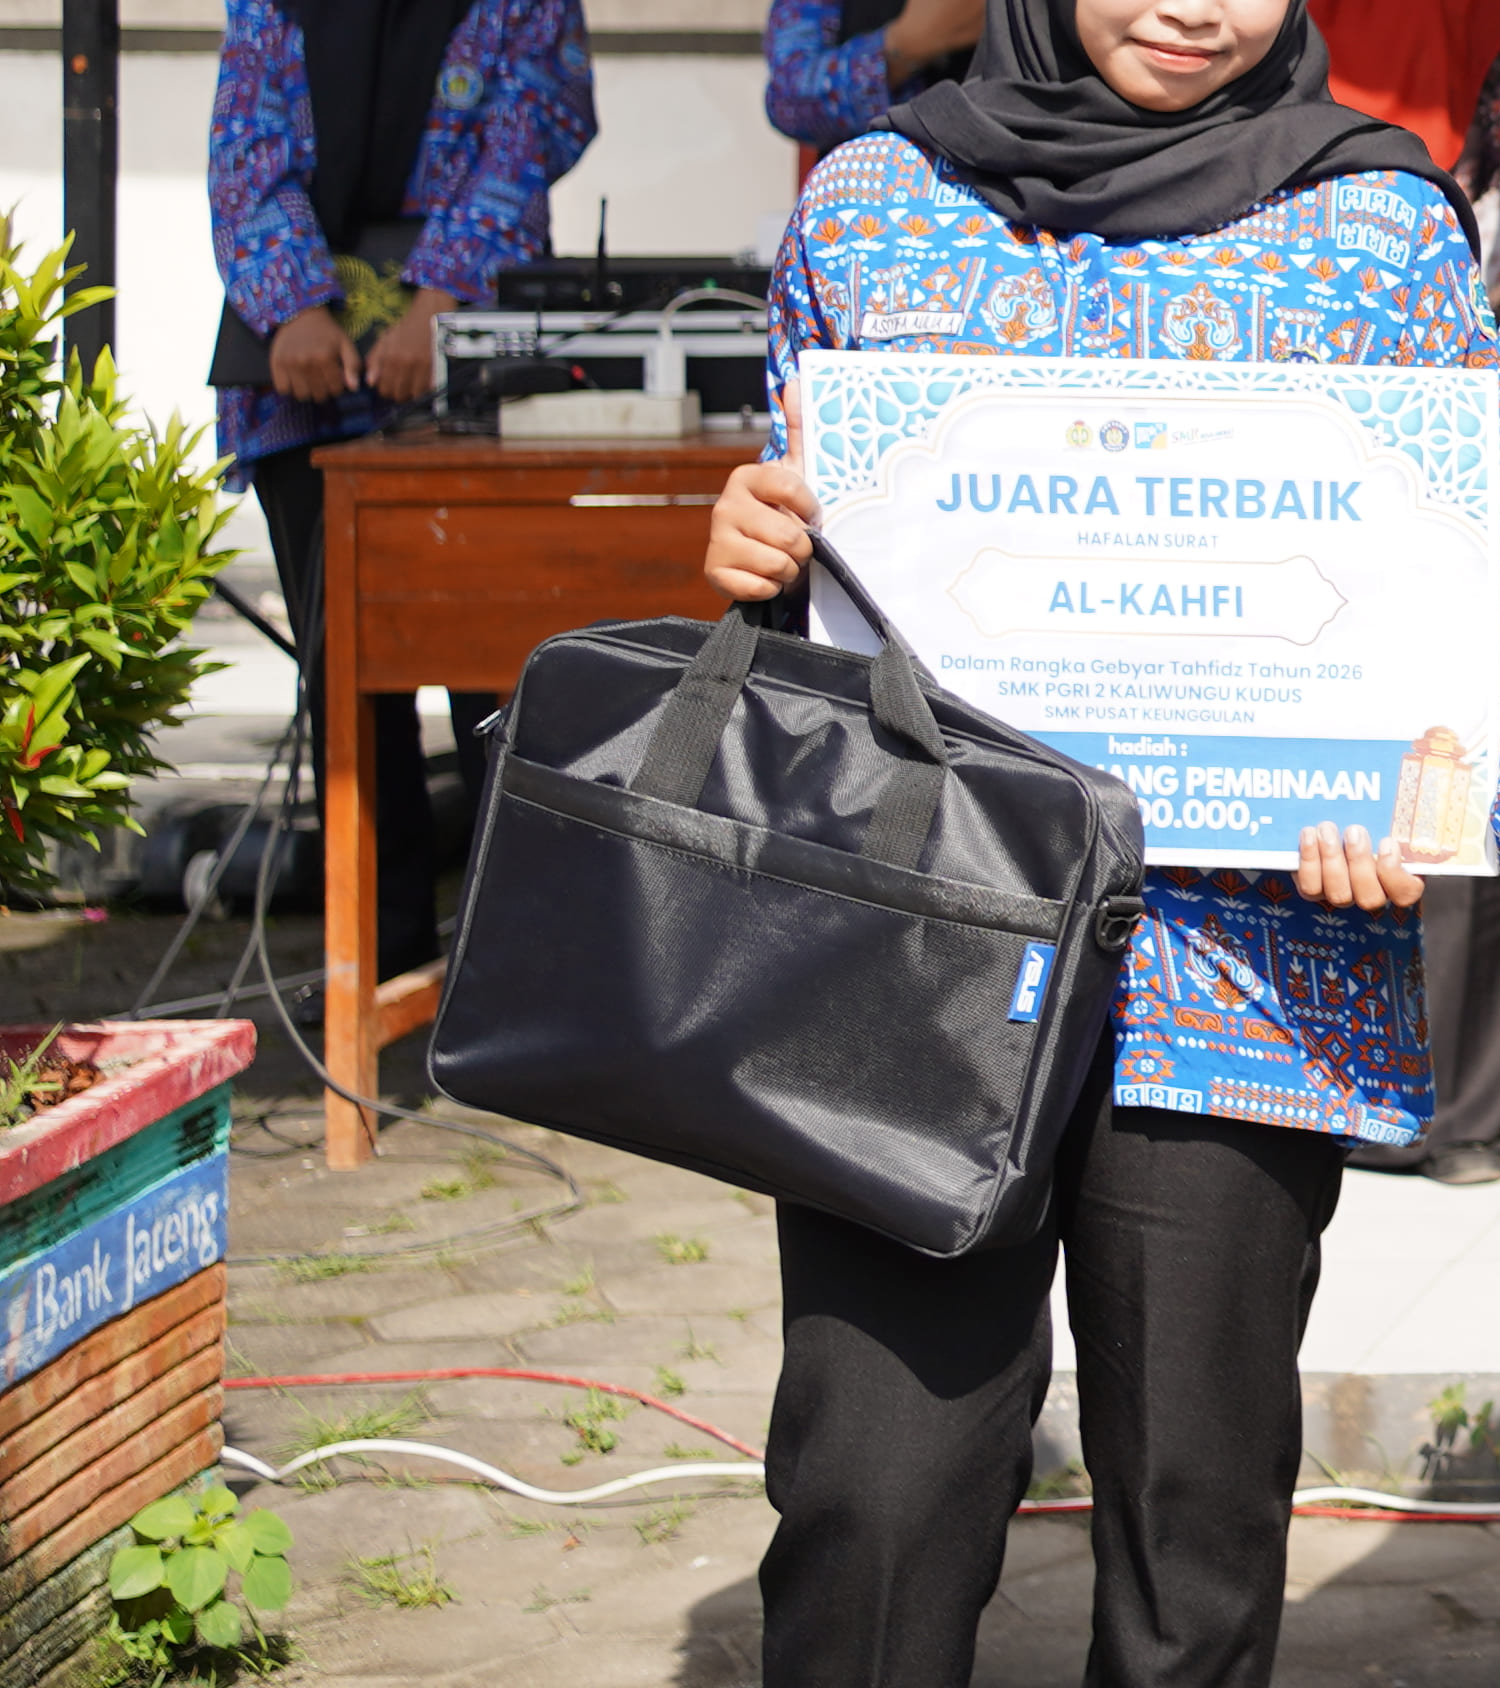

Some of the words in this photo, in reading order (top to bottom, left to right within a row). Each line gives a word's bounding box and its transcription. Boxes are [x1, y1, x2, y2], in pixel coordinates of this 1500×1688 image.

[934, 472, 1120, 516] JUARA
[1134, 475, 1361, 522] TERBAIK
[1076, 531, 1159, 547] HAFALAN
[1163, 532, 1218, 548] SURAT
[1047, 580, 1243, 618] AL-KAHFI
[939, 653, 1005, 671] Dalam
[1009, 655, 1085, 679] Rangka
[1089, 658, 1165, 680] Gebyar
[1168, 659, 1242, 677] Tahfidz
[1247, 661, 1311, 678] Tahun
[1315, 662, 1362, 680] 2026
[997, 680, 1040, 697] SMK
[1044, 681, 1090, 698] PGRI
[1094, 681, 1105, 698] 2
[1109, 683, 1230, 701] KALIWUNGU
[1234, 686, 1302, 704] KUDUS
[1044, 704, 1080, 719] SMK
[1084, 704, 1137, 720] PUSAT
[1141, 707, 1255, 723] KEUNGGULAN
[1107, 734, 1177, 757] hadiah
[1101, 763, 1181, 798] ANG
[1186, 765, 1381, 801] PEMBINAAN
[1016, 949, 1045, 1013] ASUS
[35, 1237, 113, 1338] Bank
[121, 1192, 220, 1312] Jateng
